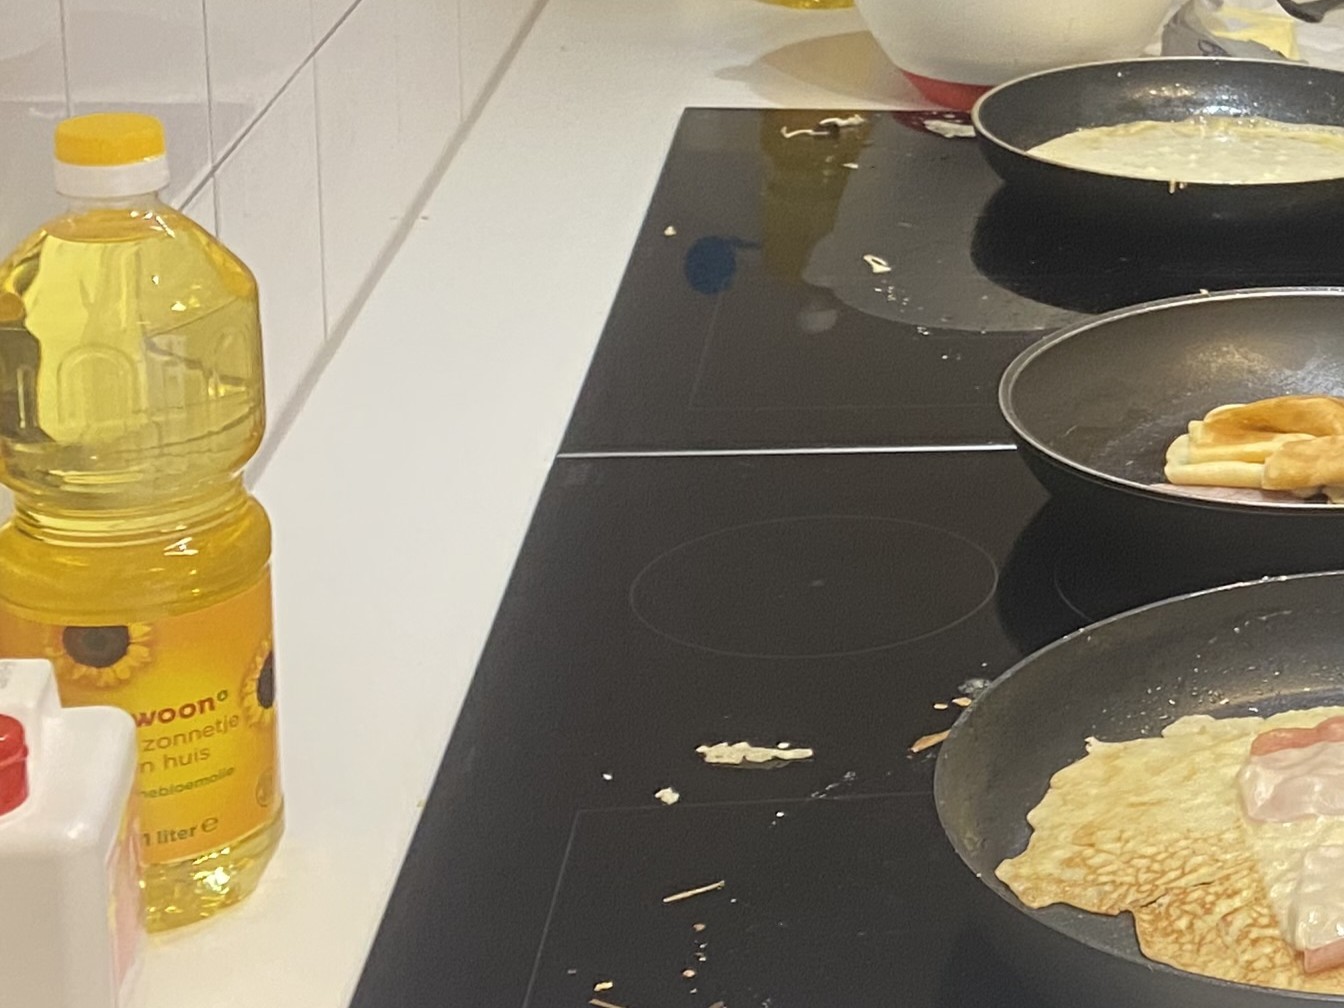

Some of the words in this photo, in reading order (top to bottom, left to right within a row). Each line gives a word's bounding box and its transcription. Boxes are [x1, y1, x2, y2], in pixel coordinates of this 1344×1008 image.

[143, 714, 240, 753] zonnetje
[163, 747, 211, 771] huis
[156, 825, 197, 844] liter
